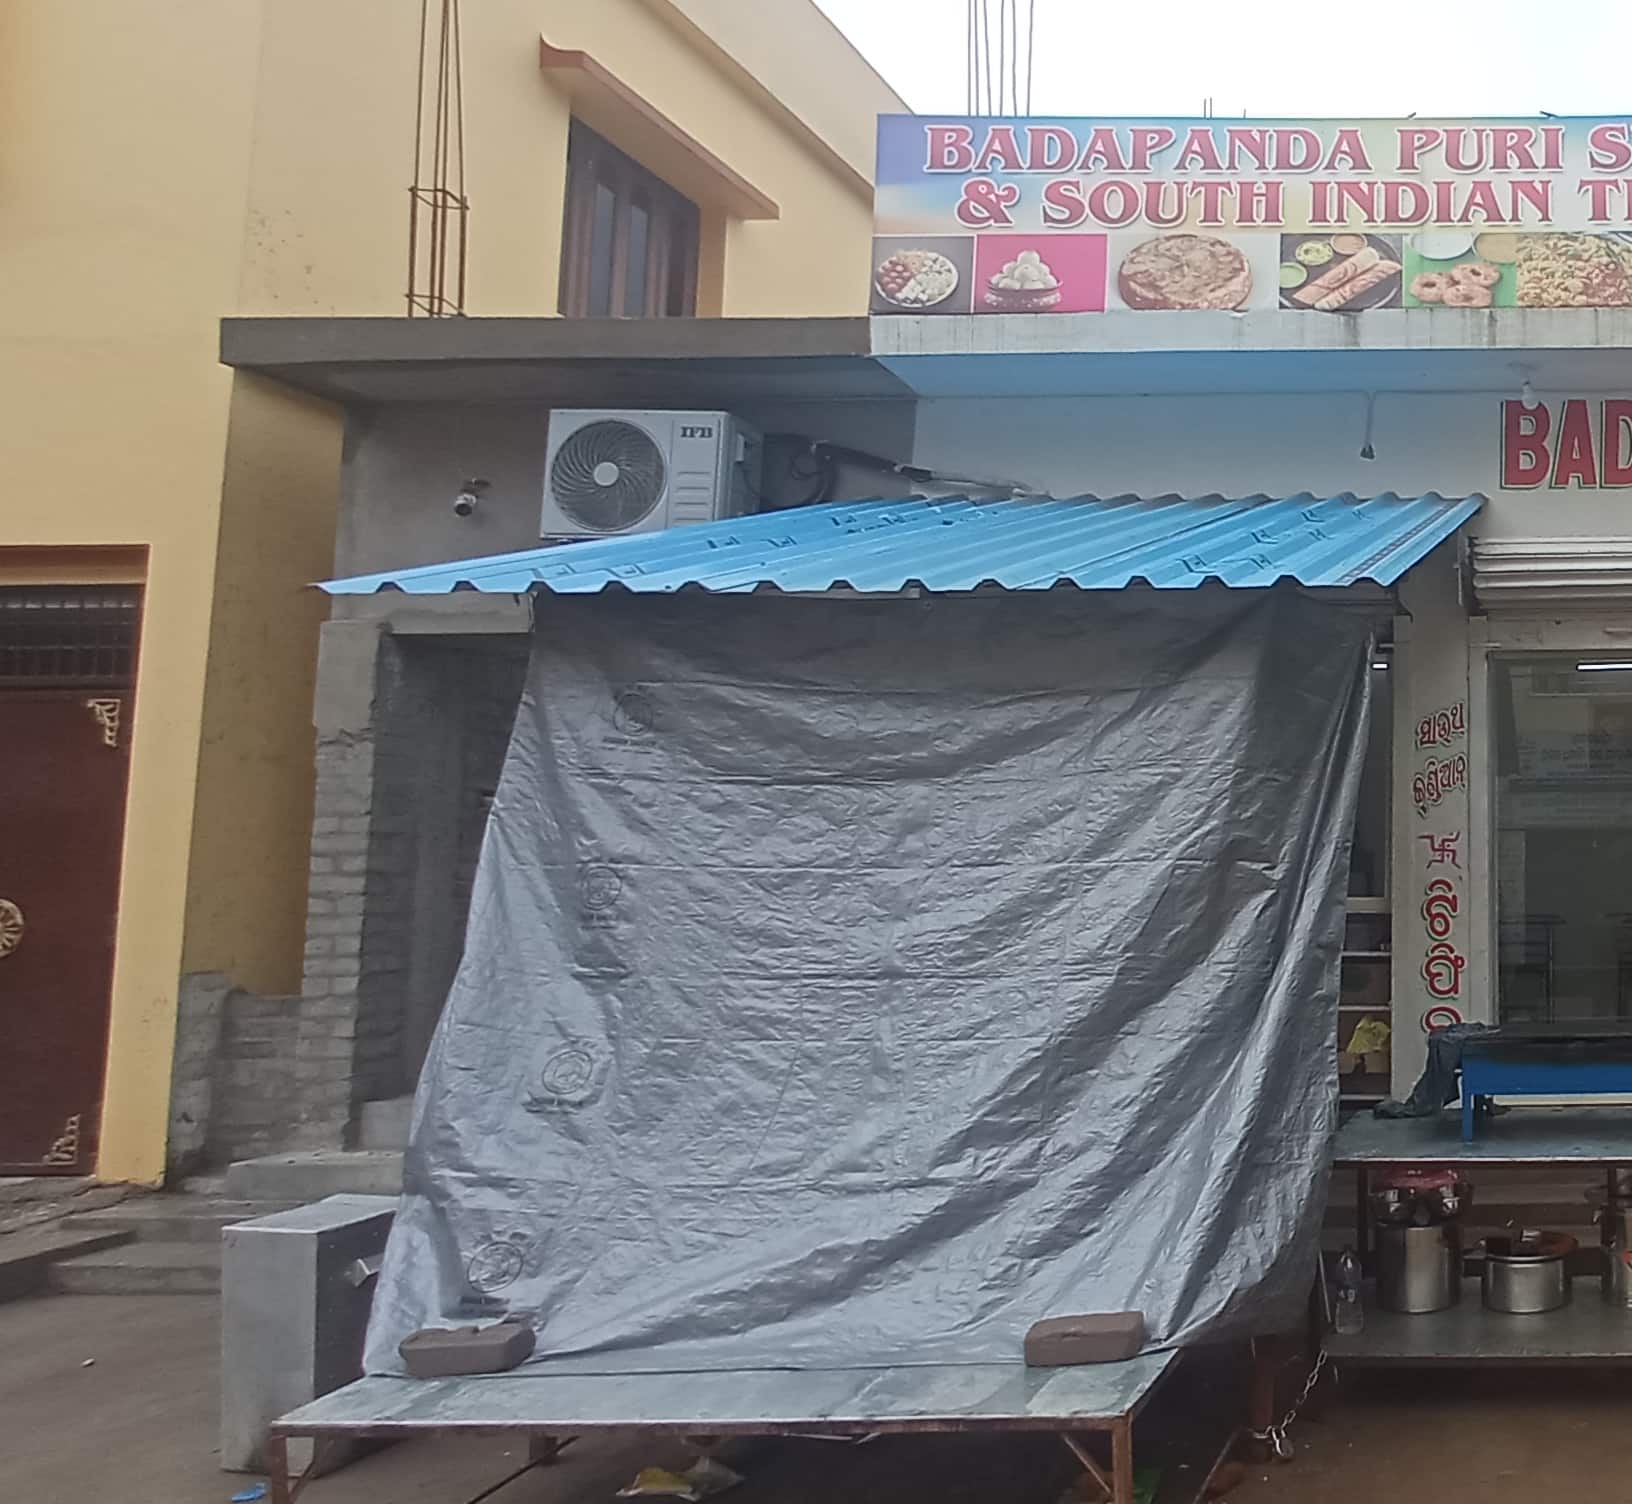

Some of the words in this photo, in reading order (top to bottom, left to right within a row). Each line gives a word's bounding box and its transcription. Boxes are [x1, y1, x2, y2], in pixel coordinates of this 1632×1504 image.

[925, 127, 1373, 173] BADAPANDA
[1397, 126, 1563, 172] PURI
[957, 179, 1019, 228] &
[1042, 179, 1284, 227] SOUTH
[1307, 178, 1552, 227] INDIAN
[680, 426, 713, 438] IFB
